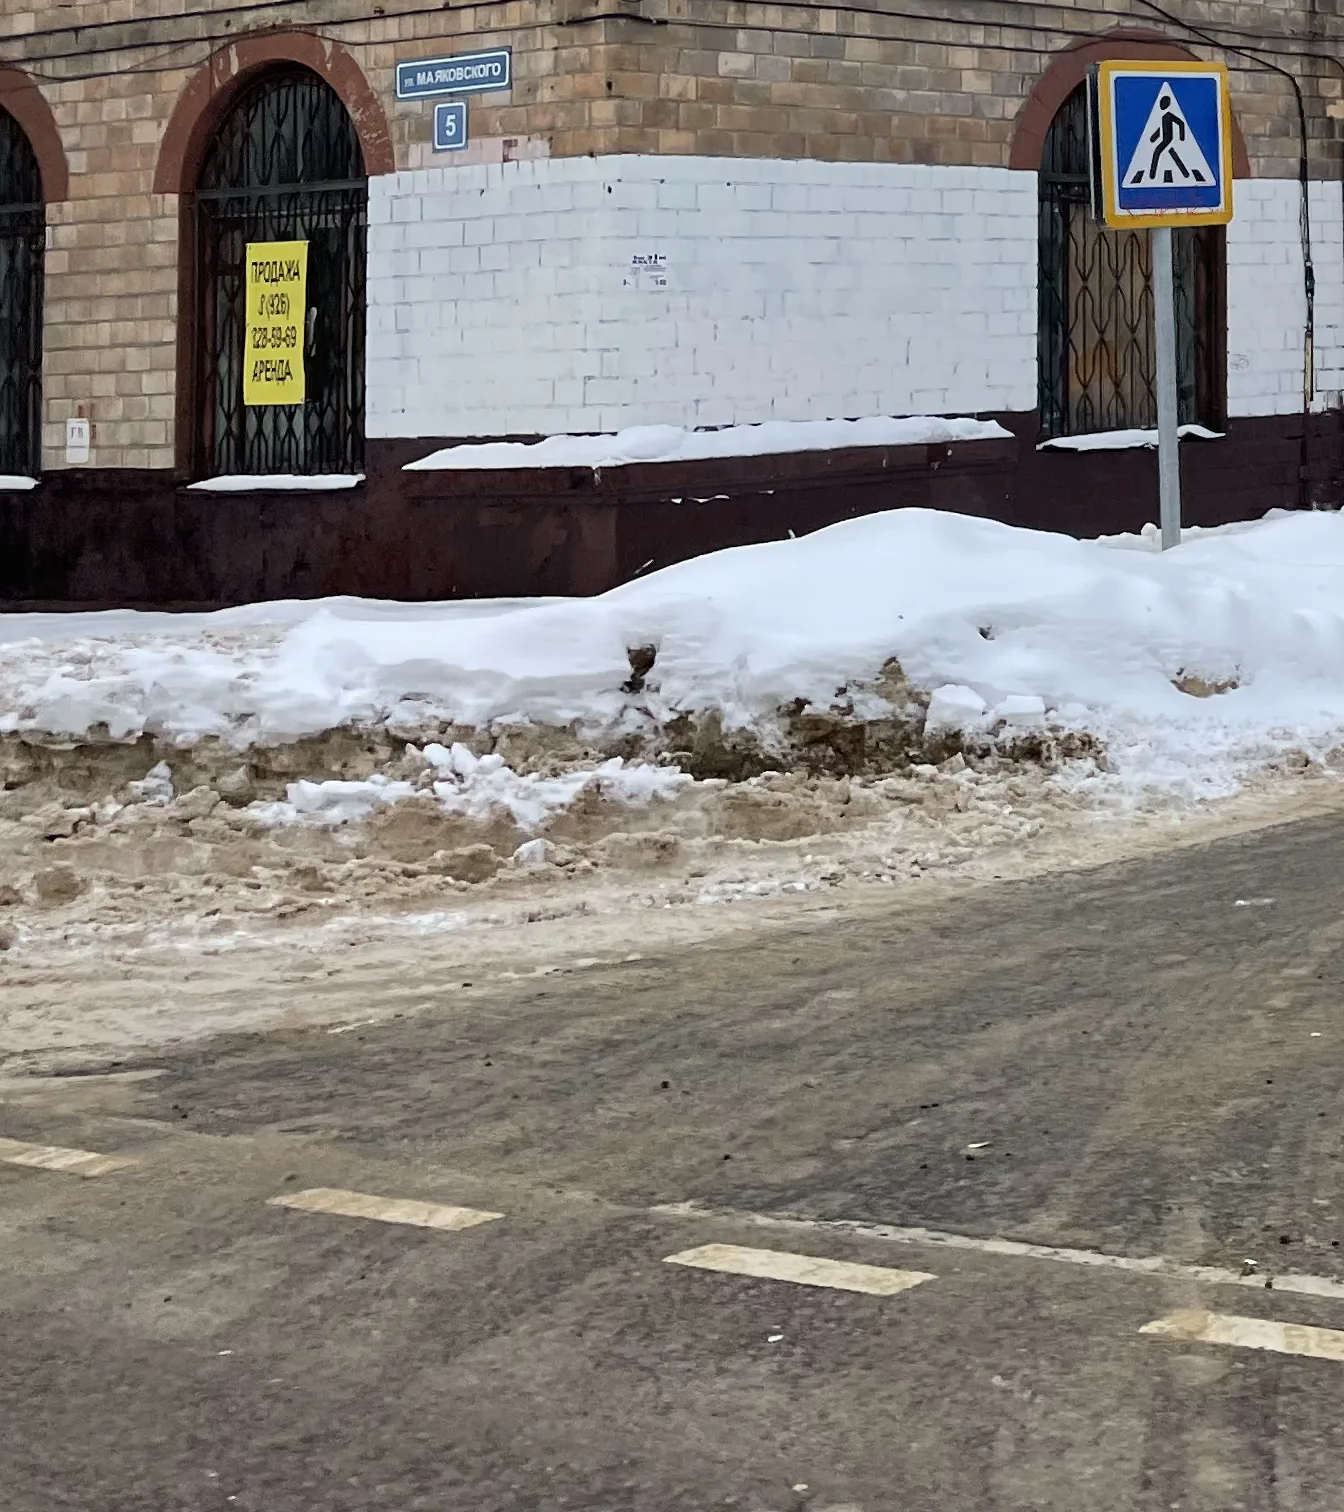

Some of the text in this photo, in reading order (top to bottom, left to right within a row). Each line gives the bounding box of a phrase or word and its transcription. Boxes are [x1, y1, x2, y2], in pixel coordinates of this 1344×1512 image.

[416, 62, 501, 85] МАЯКОВСКОГО
[445, 114, 456, 136] 5
[251, 260, 300, 286] ПРОДАЖА
[252, 359, 293, 386] АРЕНДА
